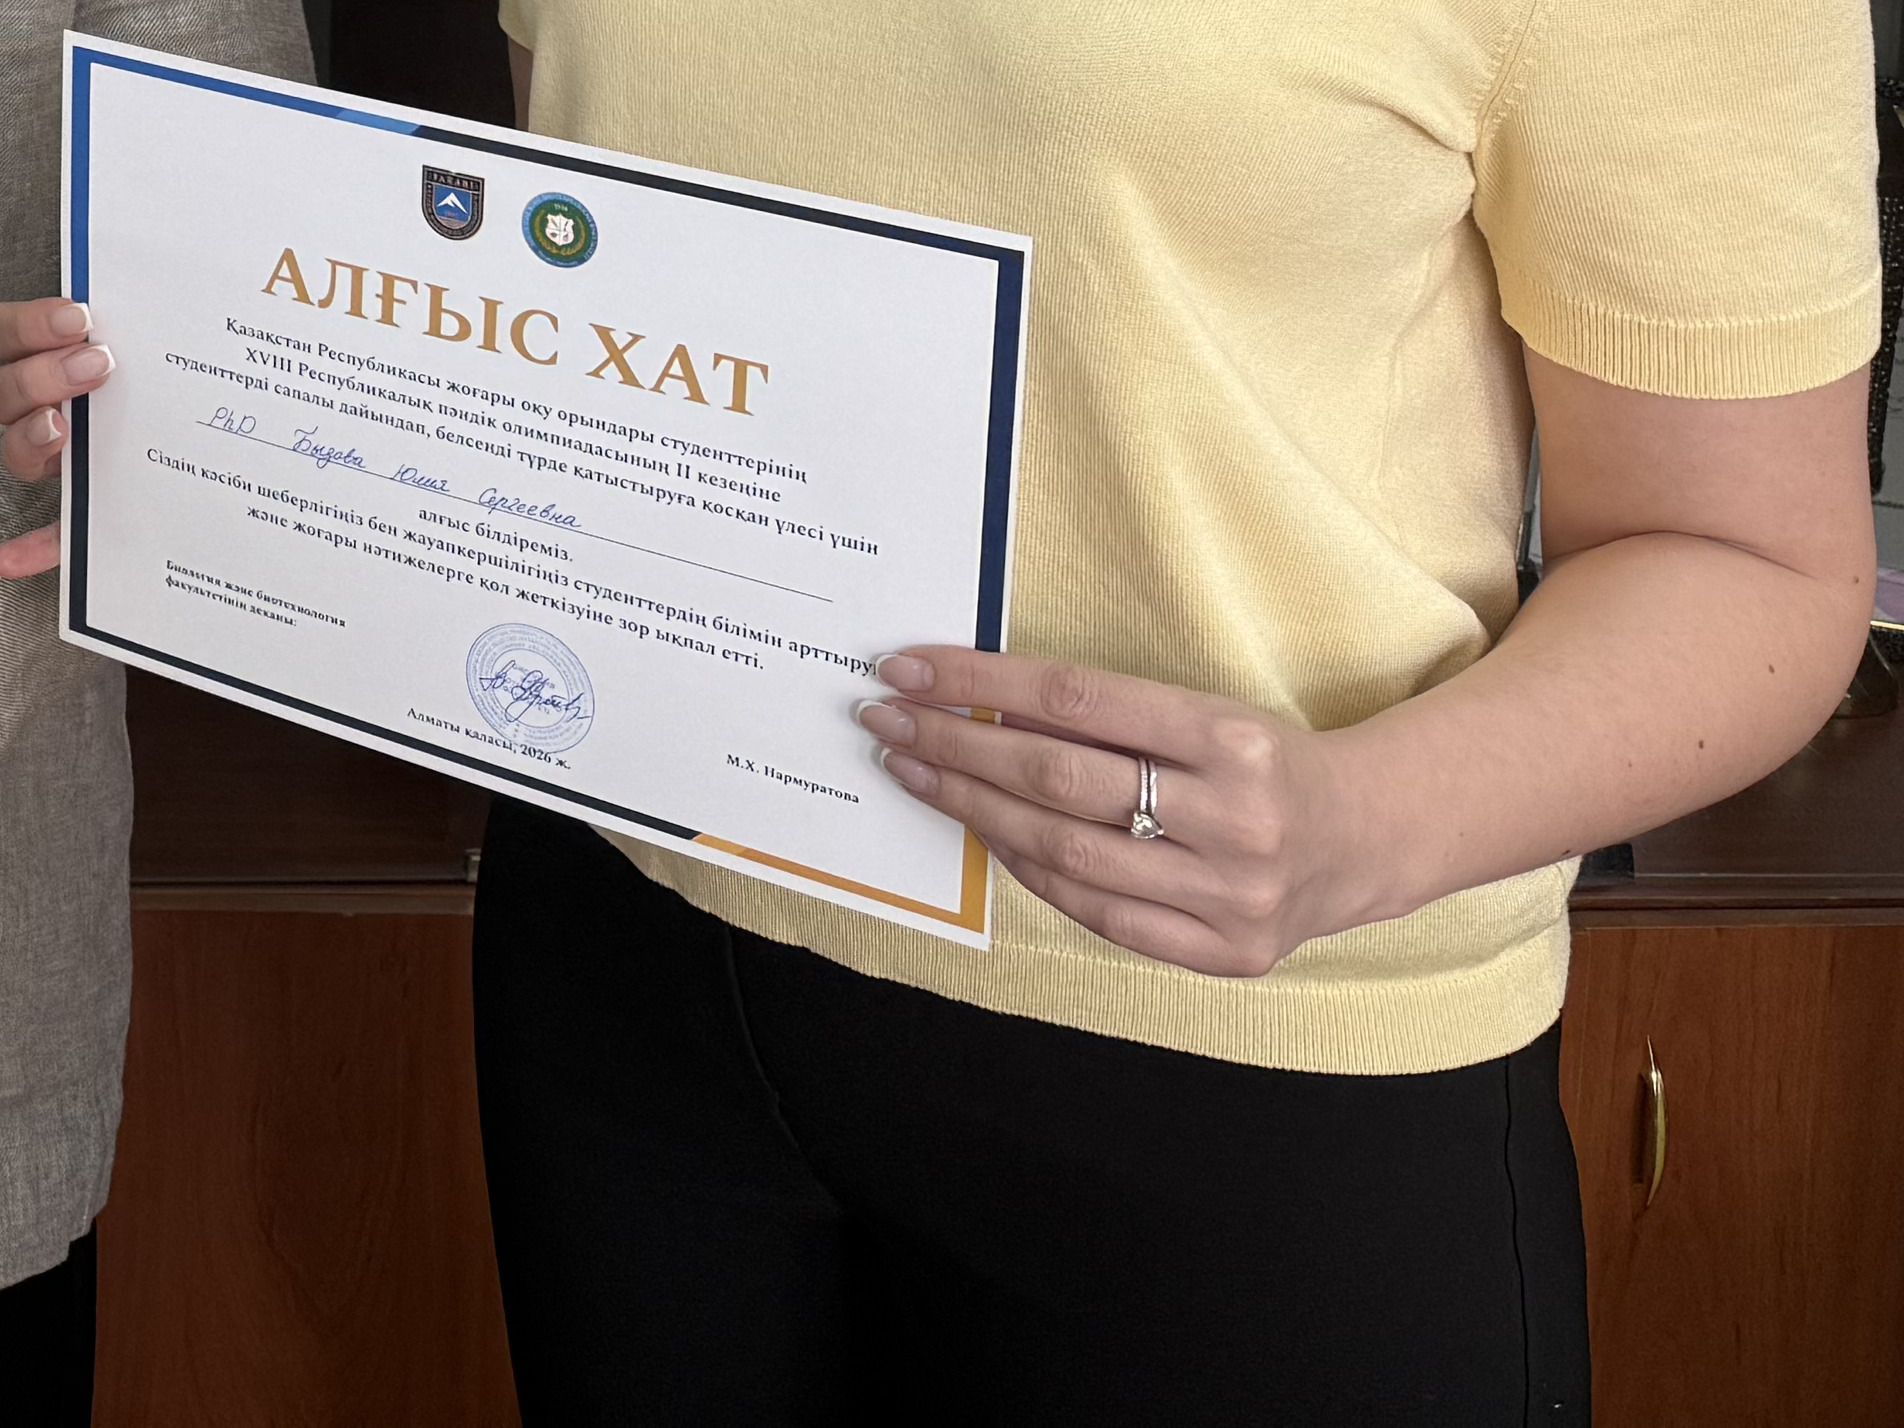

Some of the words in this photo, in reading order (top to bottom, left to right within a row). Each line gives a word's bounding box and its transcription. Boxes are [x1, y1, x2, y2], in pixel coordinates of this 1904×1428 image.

[226, 317, 311, 354] Қазақстан
[318, 342, 441, 389] Республикасы
[446, 380, 515, 408] жоғары
[521, 400, 553, 421] оқу
[557, 410, 654, 444] орындары
[660, 436, 807, 485] студенттерінің
[260, 247, 559, 366] АЛҒЫС
[585, 322, 769, 417] ХАТ
[165, 352, 269, 391] студенттерді
[274, 384, 334, 410] сапалы
[338, 402, 431, 438] дайындап,
[435, 425, 511, 459] белсенді
[516, 450, 568, 473] түрде
[574, 465, 696, 508] қатыстыруға
[702, 499, 769, 527] қосқан
[775, 518, 824, 541] үлесі
[829, 533, 878, 556] үшін
[245, 347, 292, 373] XVIII
[298, 362, 434, 413] Республикалық
[438, 403, 497, 429] пәндік
[502, 421, 670, 476] олимпиадасының
[676, 462, 691, 480] II
[698, 471, 781, 503] кезеңіне
[147, 448, 196, 477] Сіздің
[201, 467, 251, 493] кәсіби
[257, 485, 363, 526] шеберлігіңіз
[368, 516, 397, 537] бен
[403, 529, 569, 587] жауапкершілігіңіз
[573, 579, 707, 628] студенттердің
[712, 615, 782, 648] білімін
[247, 506, 288, 528] және
[363, 542, 474, 585] нәтижелерге
[479, 577, 509, 596] қол
[515, 588, 614, 625] жеткізуіне
[619, 618, 650, 640] зор
[655, 628, 715, 656] ықпал
[721, 648, 764, 670] етті.
[419, 509, 470, 533] алғыс
[475, 522, 573, 562] білдіреміз.
[726, 754, 760, 773] М.Х.
[764, 765, 859, 804] Нармуратова
